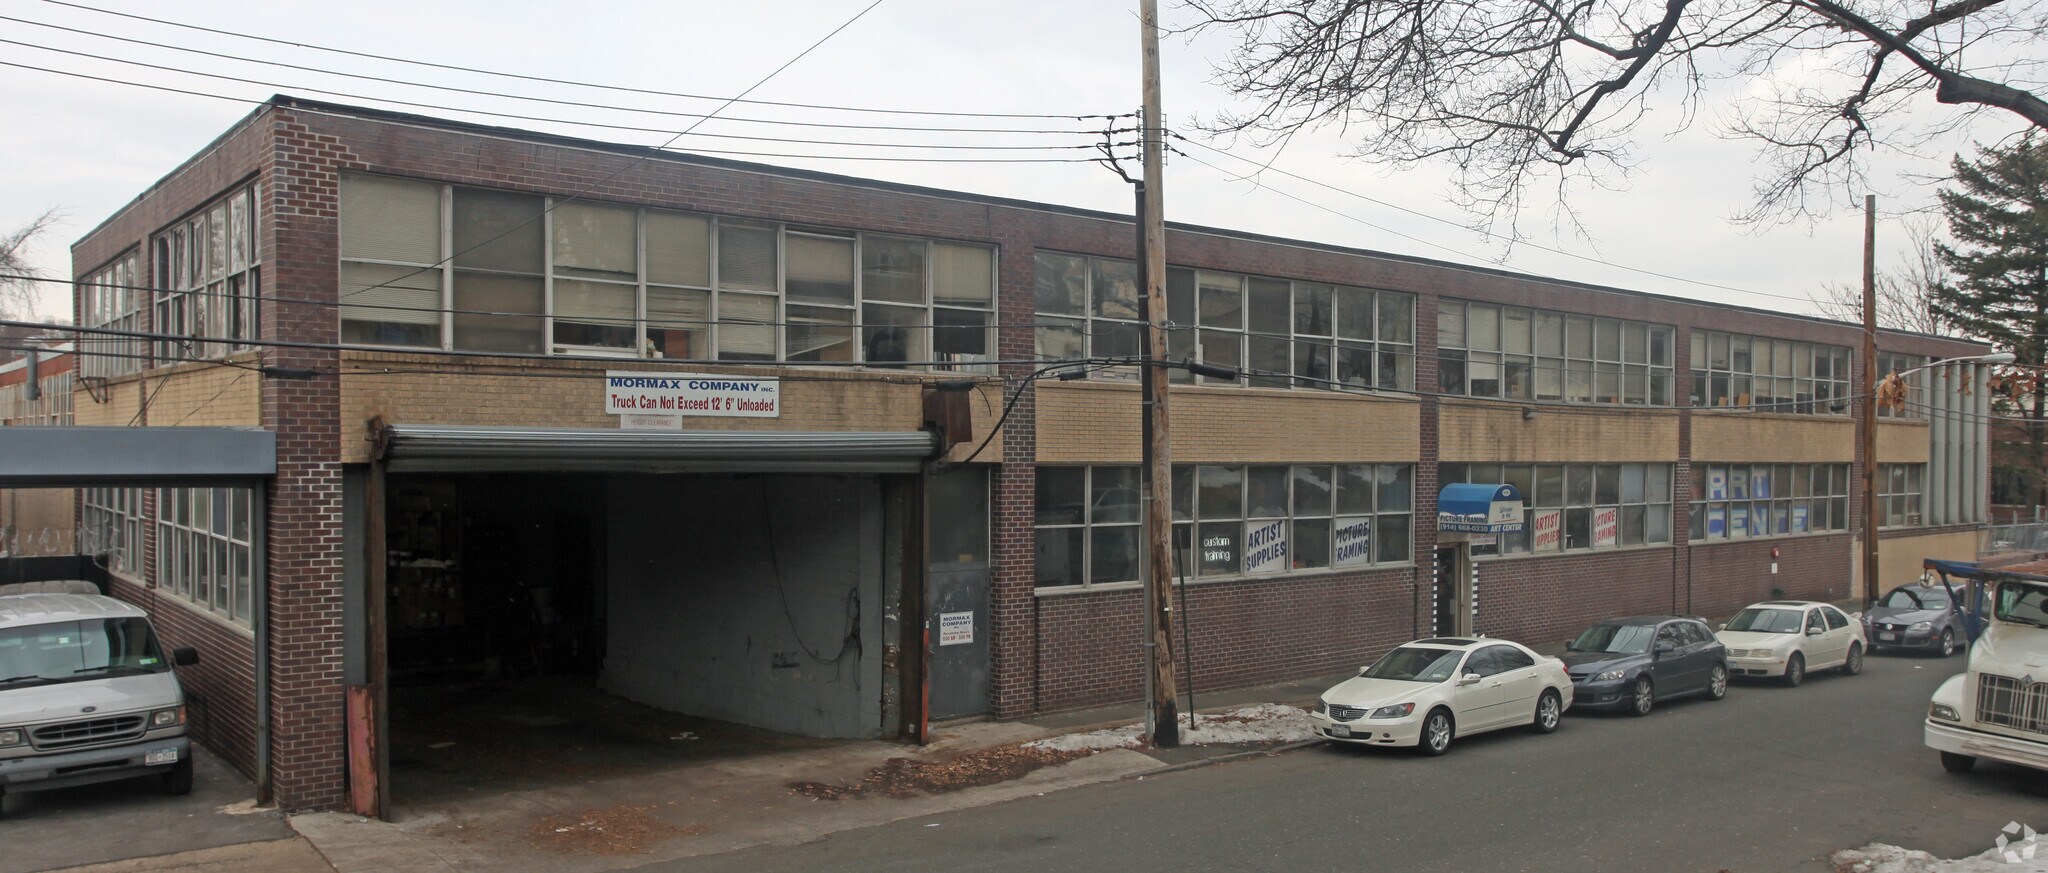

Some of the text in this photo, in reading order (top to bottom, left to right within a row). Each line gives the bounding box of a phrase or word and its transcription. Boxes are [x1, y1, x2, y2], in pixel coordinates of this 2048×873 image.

[610, 377, 680, 389] MORMAX
[689, 381, 759, 392] COMPANY
[612, 394, 774, 411] Truck Can Not Exceed 12' 6" Unloaded
[1709, 468, 1769, 498] ART
[1440, 514, 1489, 524] PICTURE FRAMING
[1440, 524, 1457, 532] (914)
[1502, 524, 1523, 532] CENTER
[1536, 512, 1559, 532] ARTIST
[1595, 510, 1615, 531] ICTURE
[1203, 535, 1230, 547] custom
[1248, 520, 1282, 552] ARTIST
[1336, 522, 1368, 543] PICTURE
[1536, 529, 1561, 547] UPPLIES
[1204, 549, 1231, 561] framing
[1247, 541, 1287, 571] SUPPLIES
[1336, 539, 1368, 562] RAMING
